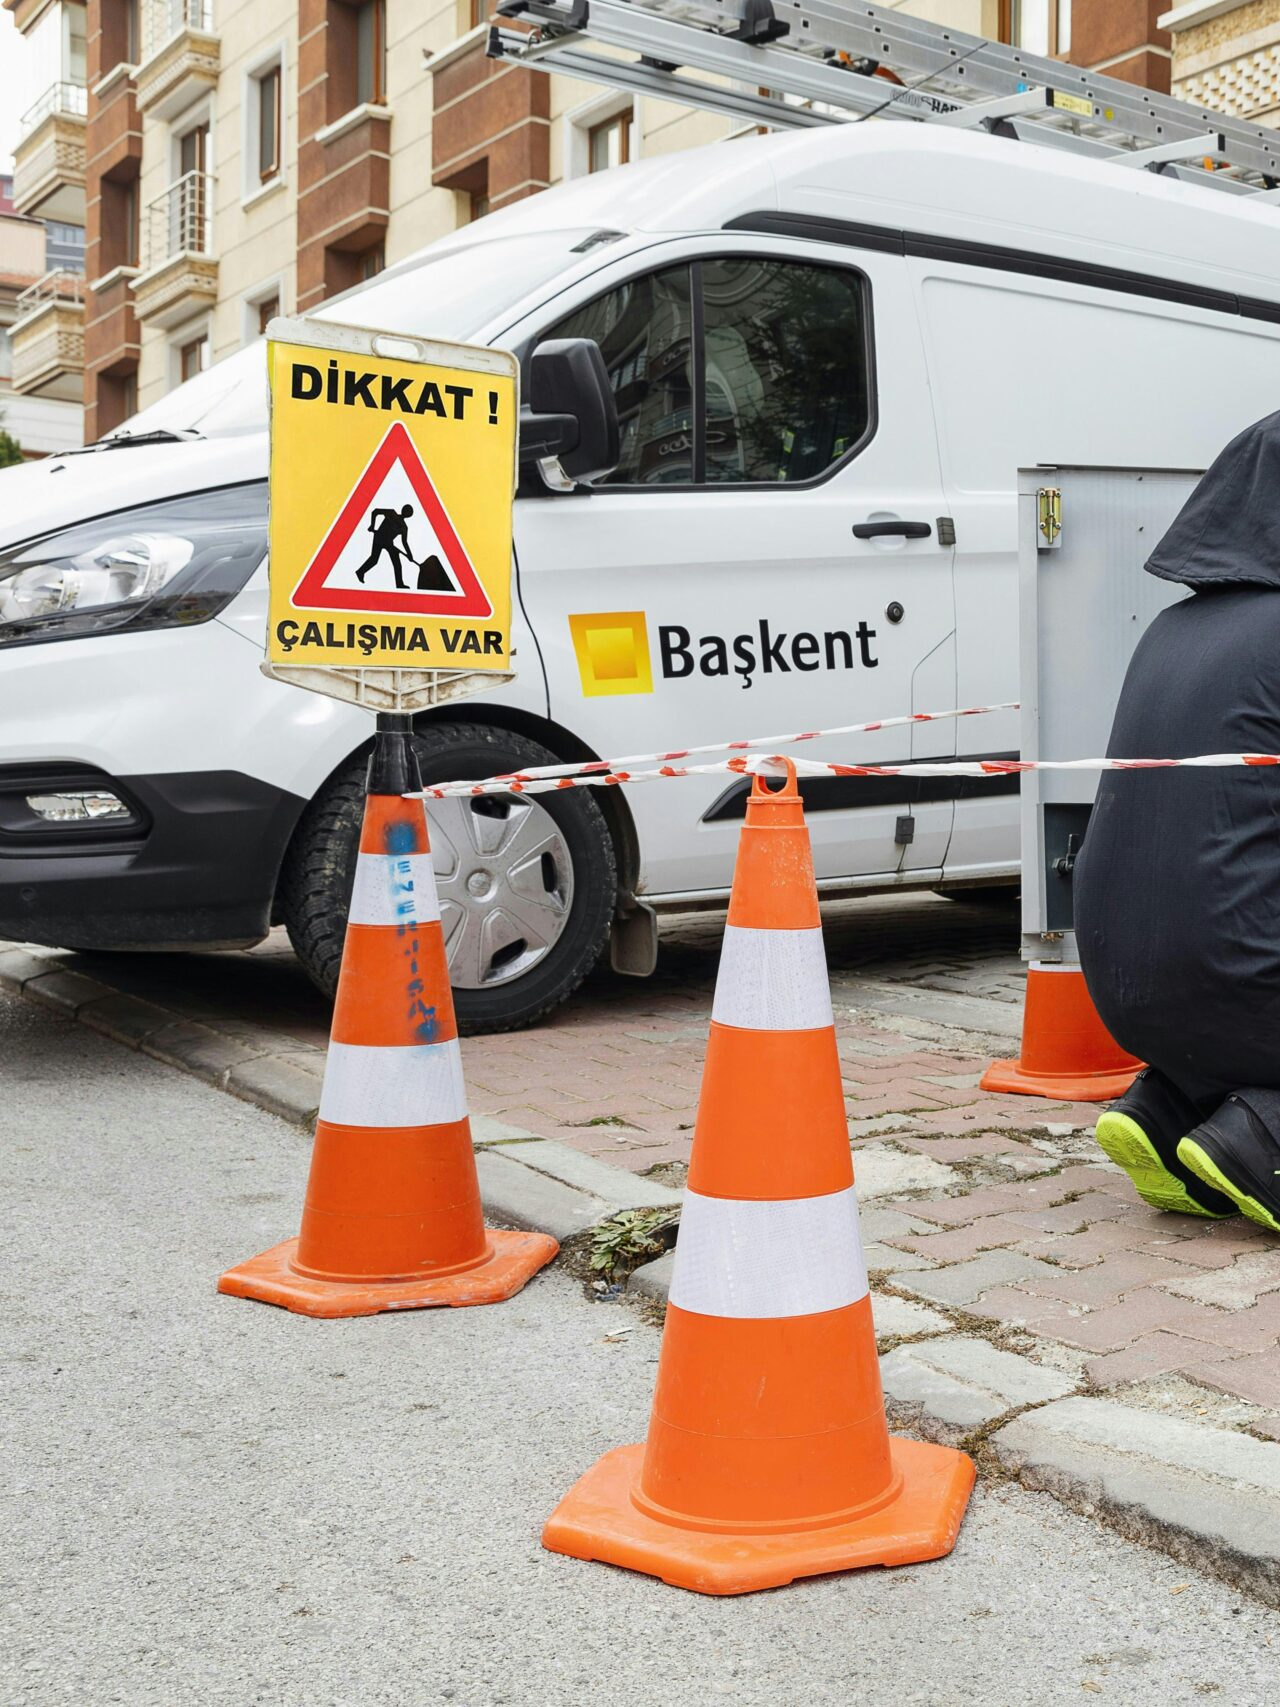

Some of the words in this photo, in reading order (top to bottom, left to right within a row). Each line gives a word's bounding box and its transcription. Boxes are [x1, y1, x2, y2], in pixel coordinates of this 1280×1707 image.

[291, 360, 474, 421] DİKKAT
[487, 391, 499, 425] !
[276, 619, 431, 656] ÇALIŞMA
[440, 628, 504, 655] VAR
[658, 618, 879, 690] Başkent
